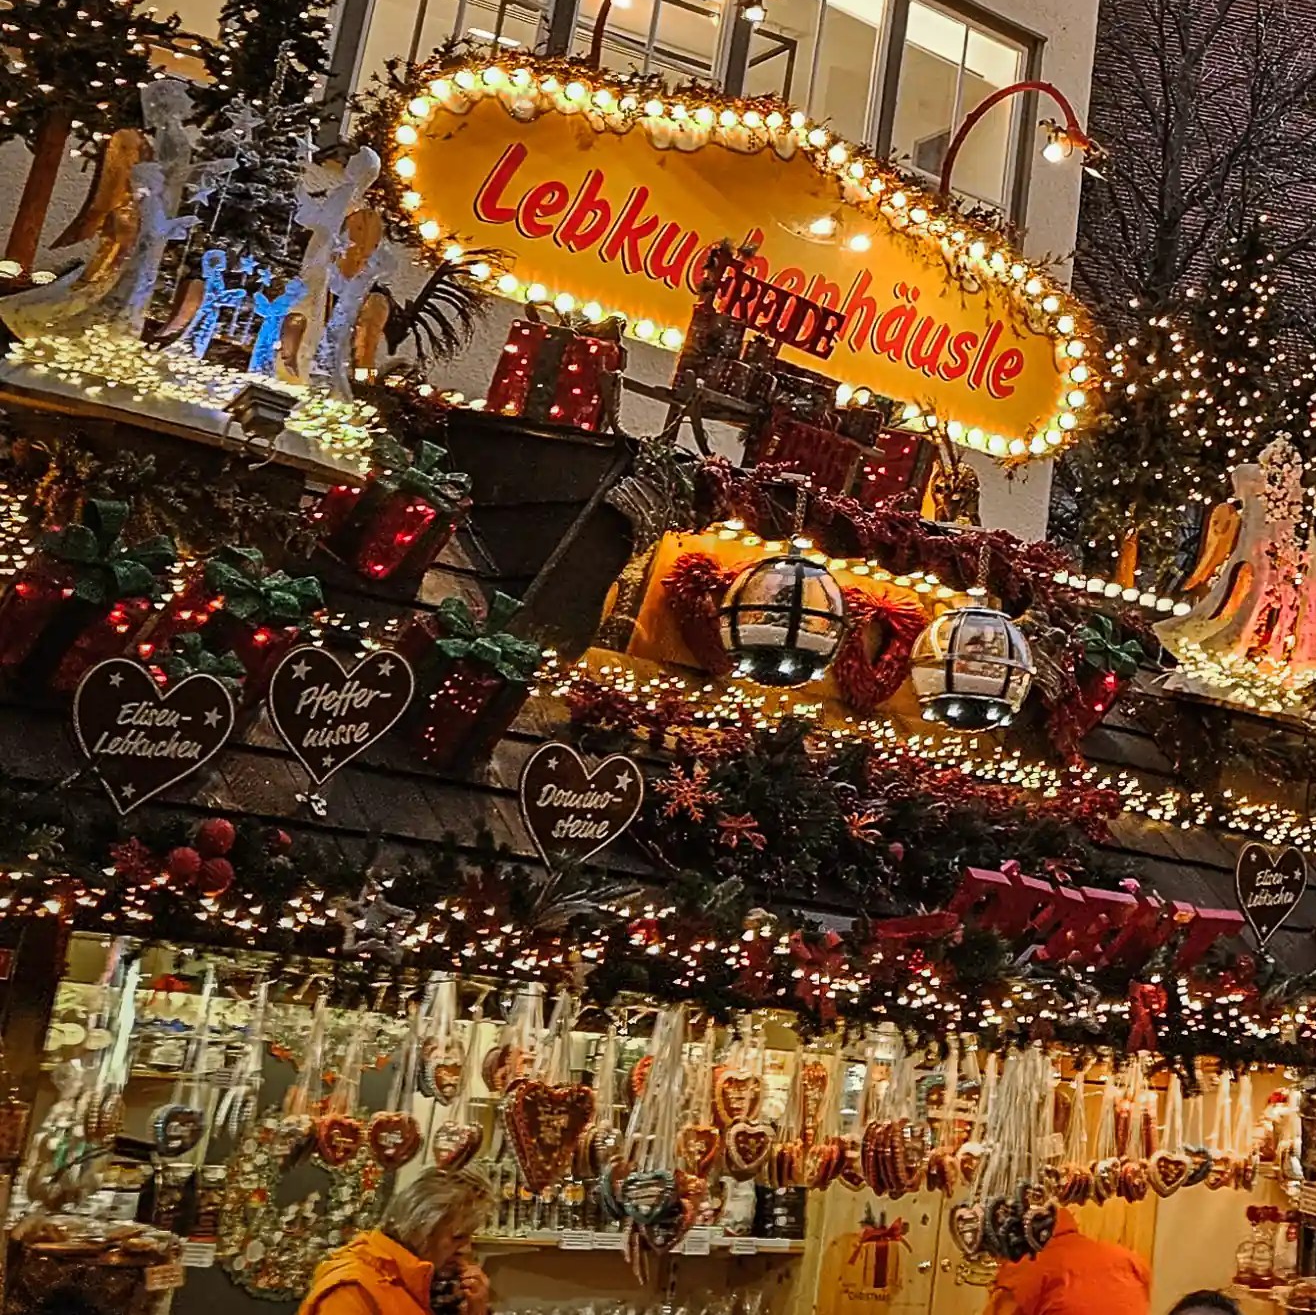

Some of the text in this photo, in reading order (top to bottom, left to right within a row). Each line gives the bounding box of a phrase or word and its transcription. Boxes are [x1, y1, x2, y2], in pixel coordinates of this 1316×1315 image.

[295, 680, 392, 719] Pfeffer-
[116, 700, 192, 728] Elisen-
[92, 729, 202, 759] Lebkuchen
[536, 783, 623, 809] Domino-
[551, 813, 610, 839] steine
